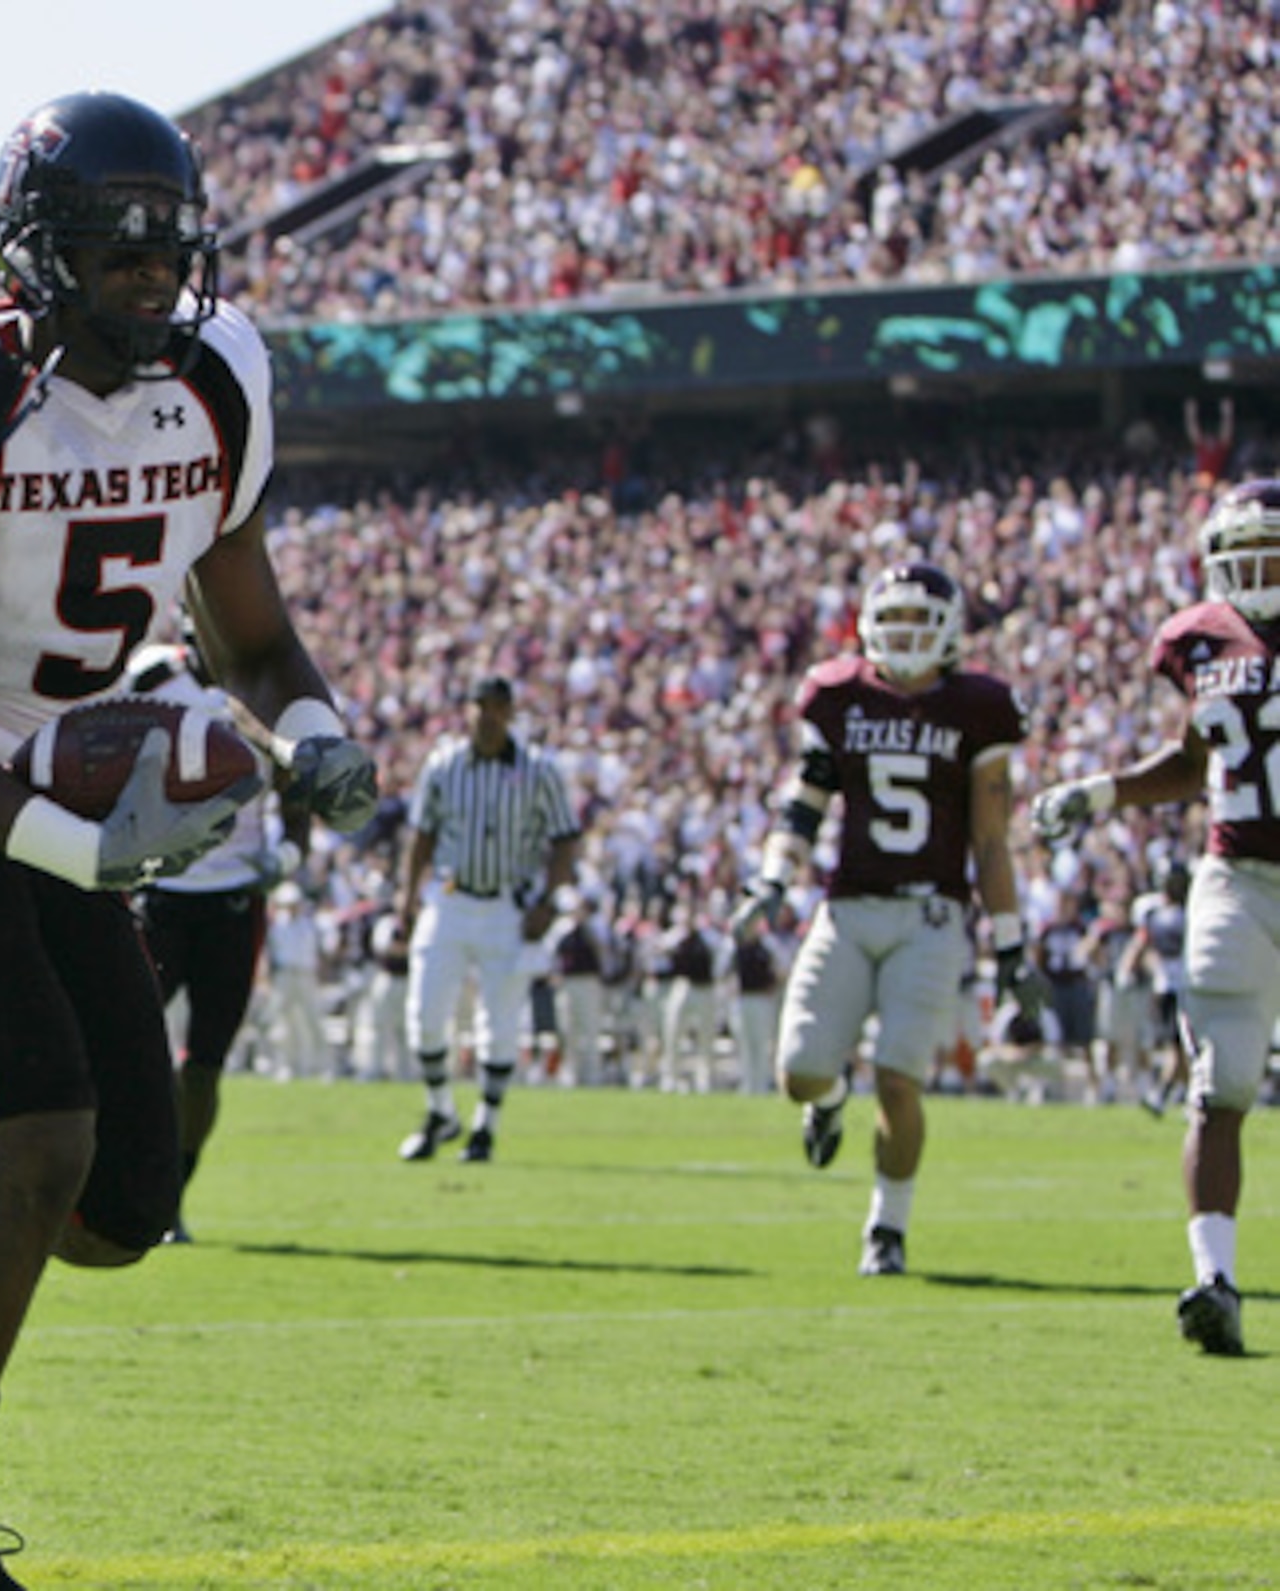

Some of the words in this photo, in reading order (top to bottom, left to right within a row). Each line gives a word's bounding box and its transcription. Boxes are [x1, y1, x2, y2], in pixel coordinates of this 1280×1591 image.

[0, 469, 130, 511] TEXAS
[142, 457, 221, 502] TECH
[33, 513, 166, 701] 5
[845, 719, 915, 752] TEXAS
[868, 753, 930, 855] 5
